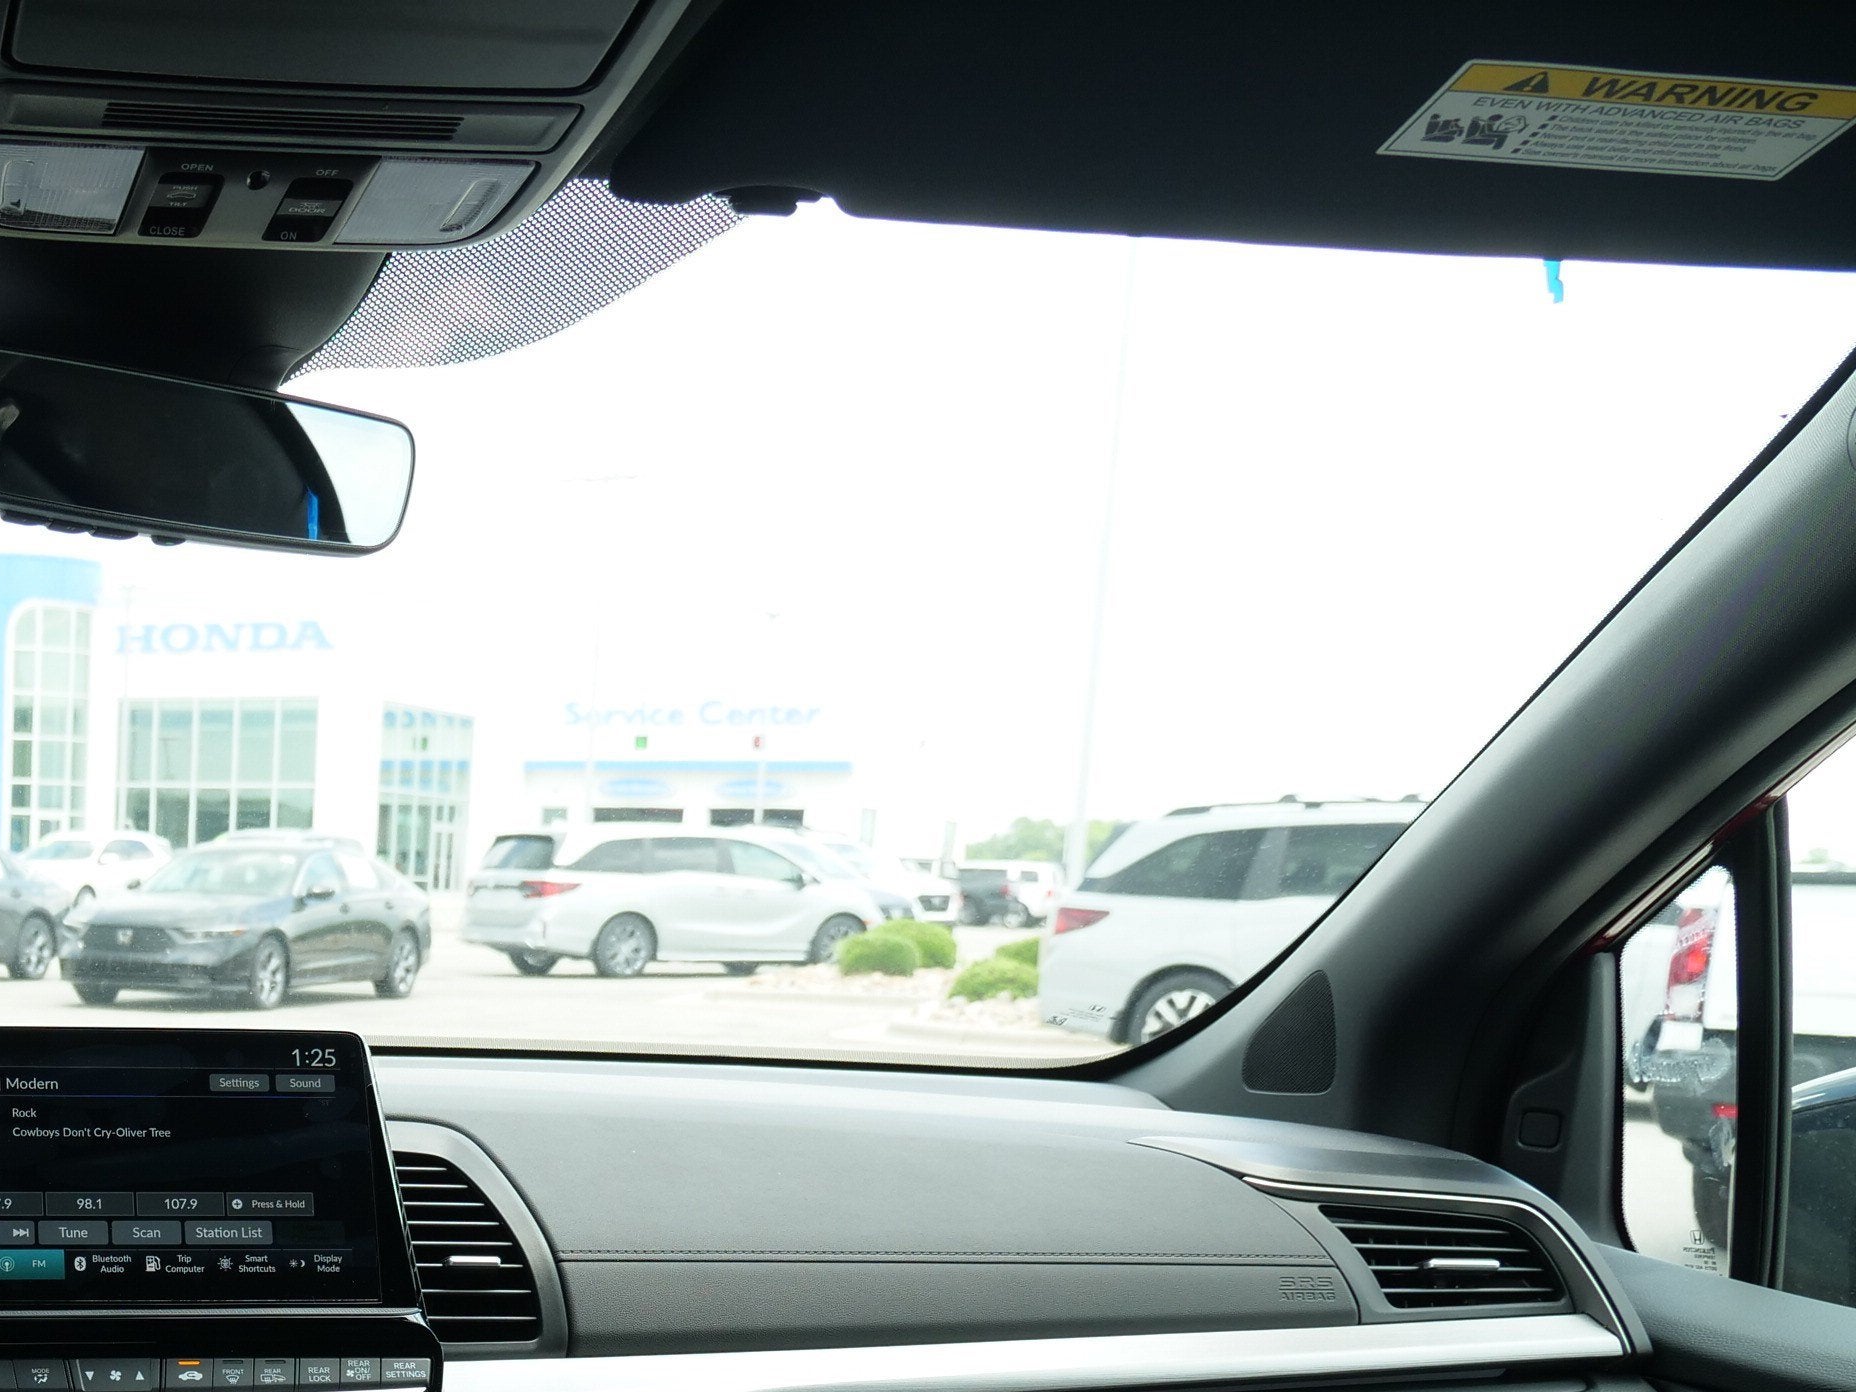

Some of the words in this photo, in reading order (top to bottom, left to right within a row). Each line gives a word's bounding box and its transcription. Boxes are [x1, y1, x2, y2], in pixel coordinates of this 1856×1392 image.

[1581, 77, 1819, 112] WARNING
[1473, 97, 1533, 109] EVEN
[1535, 101, 1589, 114] WITH
[1593, 105, 1705, 121] ADVANCED
[1705, 114, 1743, 125] AIR
[1744, 116, 1805, 128] BAGS
[181, 163, 214, 171] OPEN
[149, 226, 186, 237] CLOSE
[280, 231, 297, 240] ON
[115, 620, 336, 655] HONDA
[564, 701, 685, 727] Service
[697, 701, 822, 727] Center
[291, 1048, 337, 1067] 1:25
[6, 1077, 59, 1090] Modern
[219, 1078, 260, 1090] Settings
[289, 1078, 321, 1088] Sound
[12, 1108, 37, 1118] Rock
[12, 1127, 60, 1139] Cowboys
[63, 1127, 91, 1137] Don't
[93, 1127, 147, 1139] Cry-Oliver
[149, 1128, 171, 1138] Tree
[76, 1198, 102, 1210] 98.1
[164, 1198, 198, 1210] 107.9
[251, 1200, 274, 1209] Press
[275, 1200, 283, 1209] &
[284, 1199, 305, 1209] Hold
[58, 1227, 88, 1238] Tune
[132, 1227, 161, 1238] Scan
[195, 1227, 238, 1238] Station
[241, 1227, 263, 1238] List
[32, 1259, 46, 1268] FM
[92, 1255, 132, 1263] Bluetooth
[177, 1254, 192, 1264] Trip
[245, 1254, 268, 1263] Smart
[314, 1254, 343, 1264] Display
[100, 1265, 125, 1274] Audio
[165, 1265, 205, 1274] Computer
[238, 1265, 276, 1273] Shortcuts
[317, 1265, 341, 1273] Mode
[1279, 1276, 1333, 1288] SRS
[1279, 1291, 1336, 1301] AIRBAG
[347, 1360, 371, 1368] REAR
[393, 1362, 416, 1370] REAR
[308, 1374, 331, 1382] LOCK
[354, 1373, 372, 1381] OFF
[385, 1370, 427, 1378] SETTINGS
